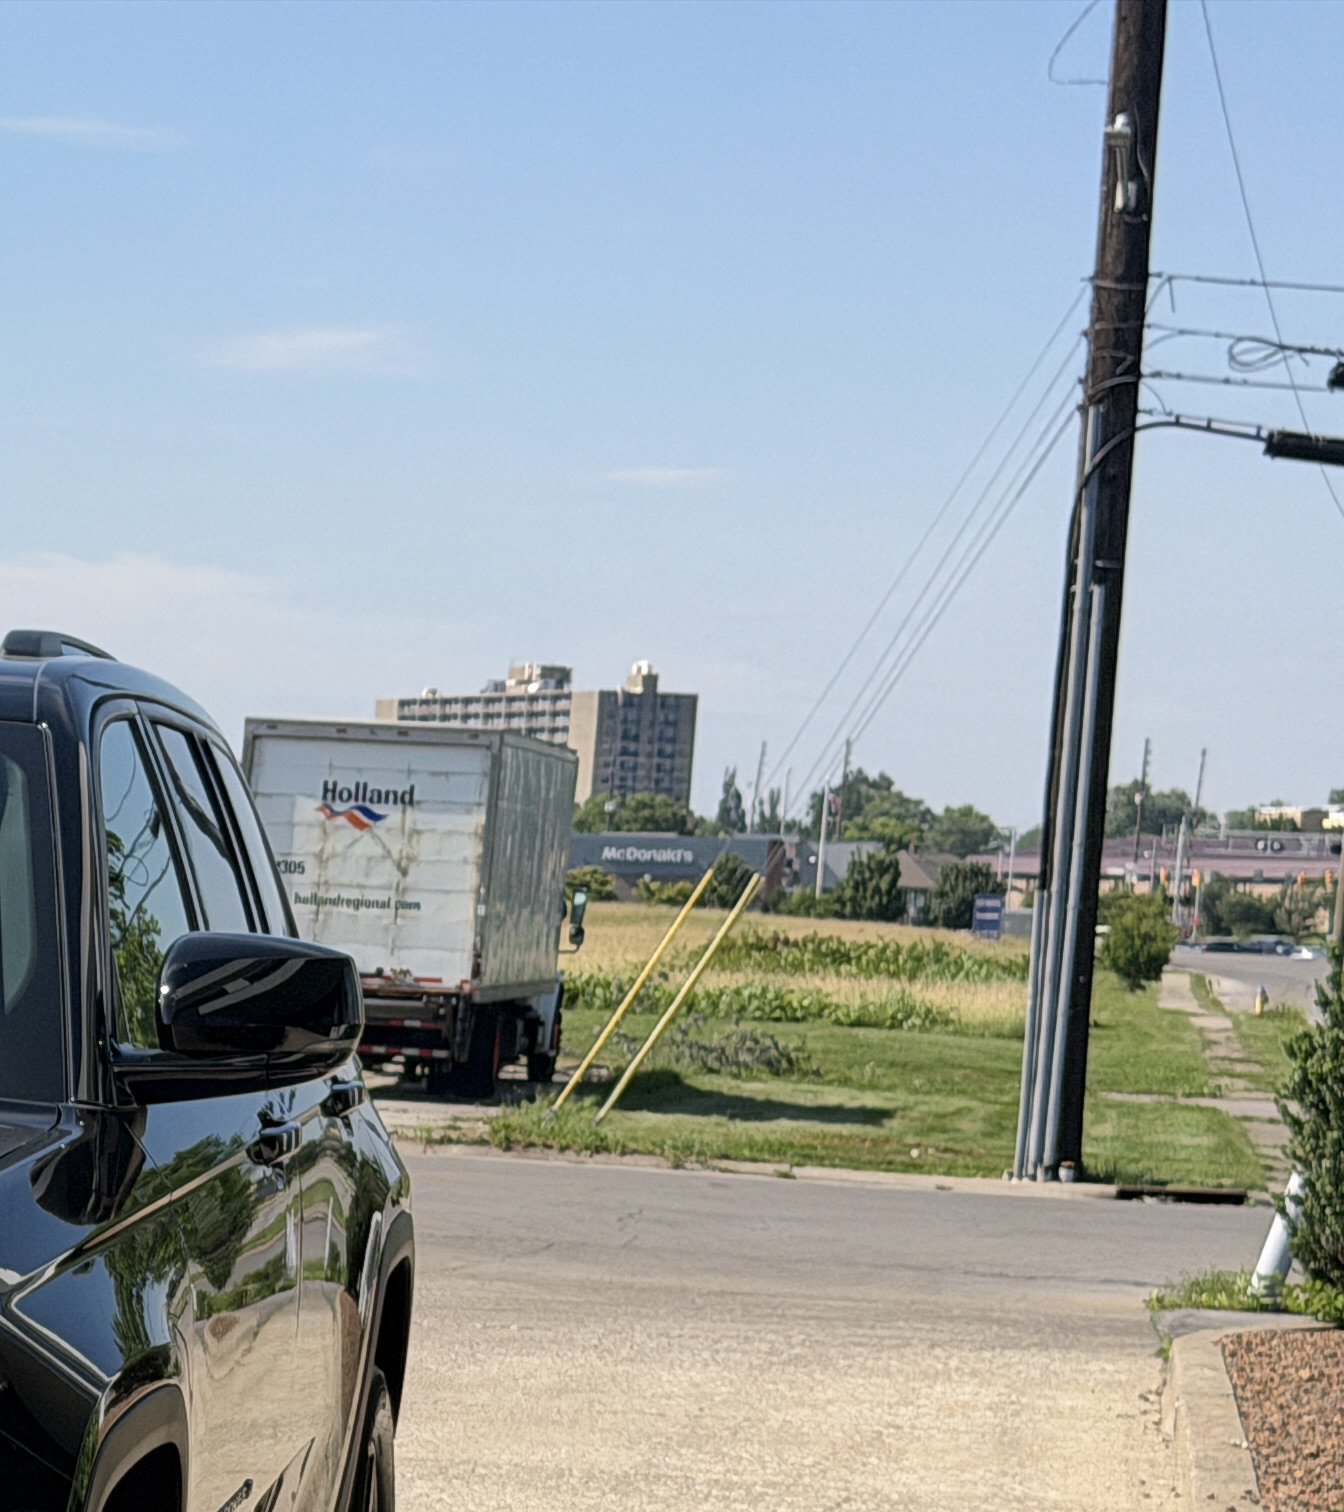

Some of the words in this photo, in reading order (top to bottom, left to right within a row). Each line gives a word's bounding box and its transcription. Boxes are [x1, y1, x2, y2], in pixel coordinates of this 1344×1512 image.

[321, 779, 416, 806] Holland
[601, 846, 694, 863] McDonald's
[293, 891, 421, 911] hollandregionalcom
